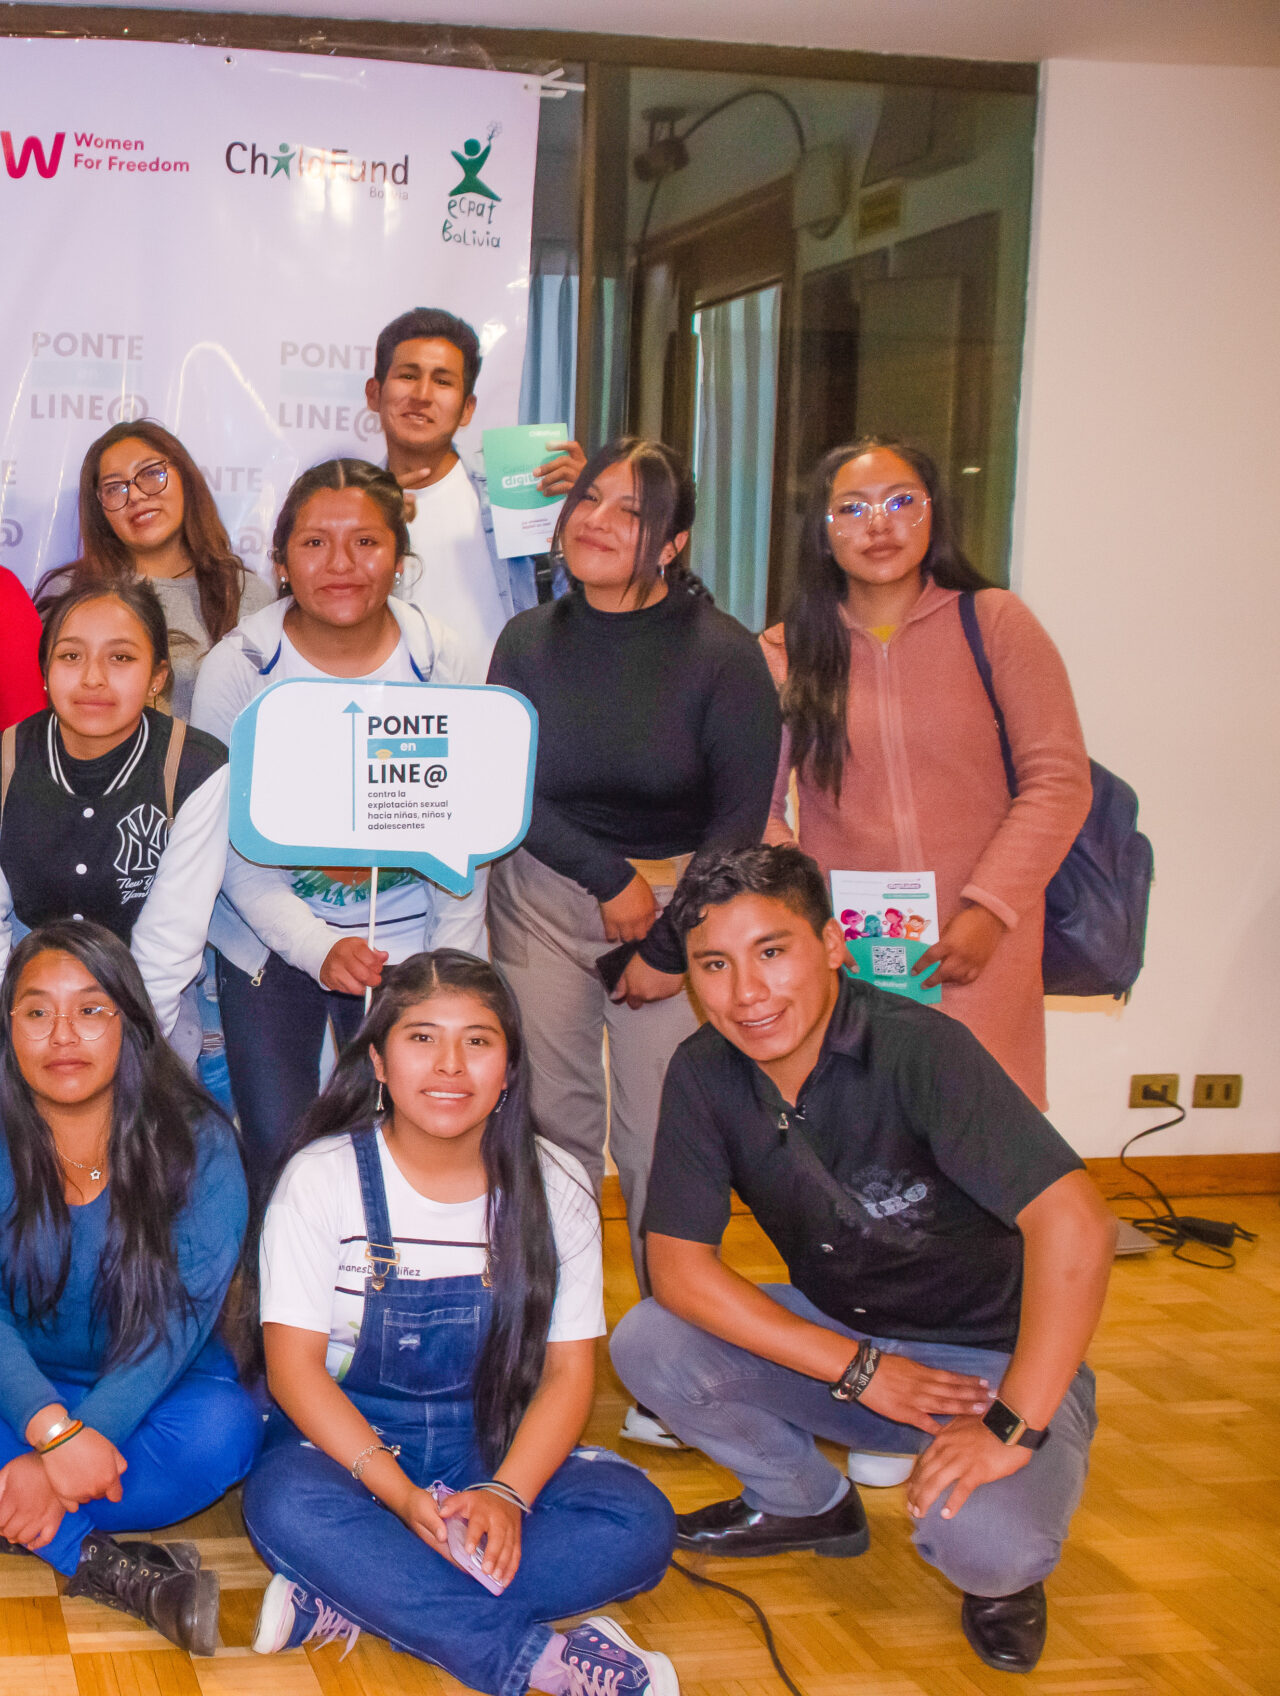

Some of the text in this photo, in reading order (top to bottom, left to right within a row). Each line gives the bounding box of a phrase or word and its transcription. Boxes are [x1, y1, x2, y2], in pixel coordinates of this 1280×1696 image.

[74, 132, 145, 151] Women
[74, 153, 190, 173] For Freedom
[32, 331, 144, 361] PONTE
[281, 341, 376, 371] PONT
[30, 393, 149, 425] LINE@
[368, 715, 448, 736] PONTE
[400, 742, 417, 752] en
[367, 790, 406, 798] contra la
[367, 800, 449, 810] explotación sexual
[367, 811, 392, 819] hacia
[394, 811, 420, 820] niñas,
[447, 811, 453, 820] y
[116, 878, 143, 889] New
